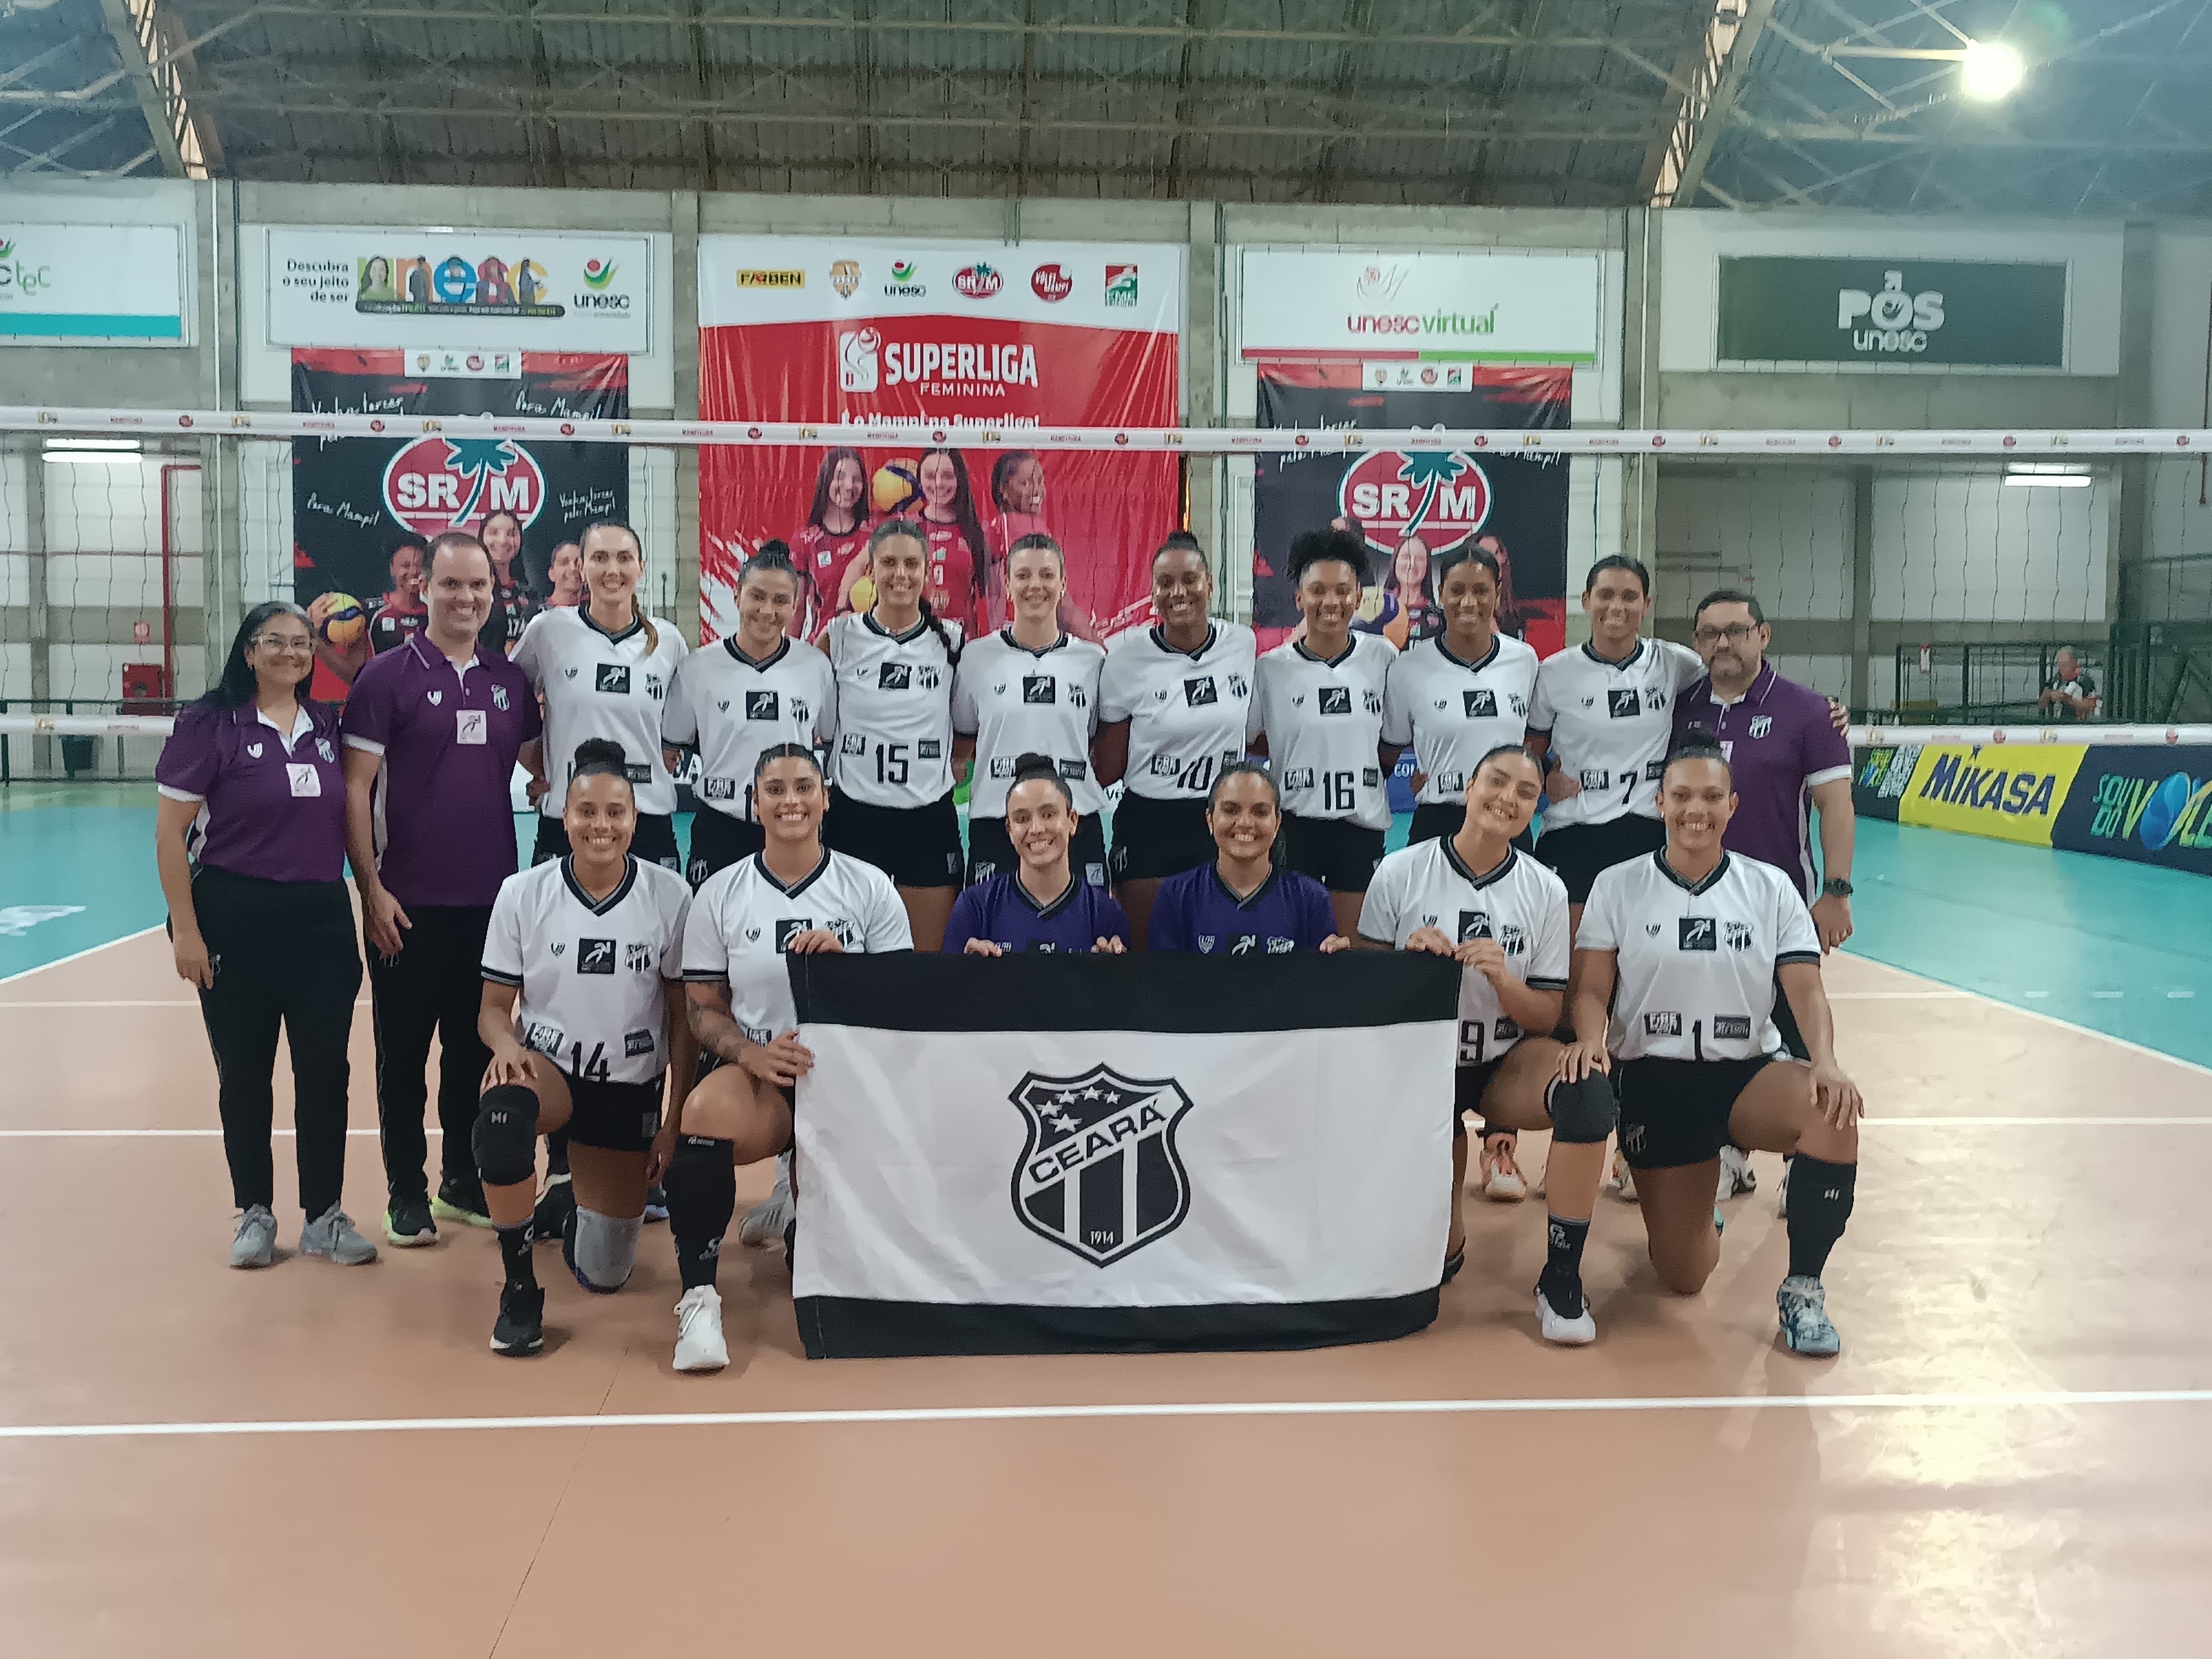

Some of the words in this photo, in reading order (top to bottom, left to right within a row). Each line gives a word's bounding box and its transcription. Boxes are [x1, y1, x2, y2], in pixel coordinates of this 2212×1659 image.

[287, 258, 349, 273] Descubra
[310, 290, 327, 302] de
[573, 293, 630, 309] unesc
[1838, 270, 1945, 331] PÓS
[1853, 330, 1928, 353] unesc
[885, 342, 1039, 388] SUPERLIGA
[920, 382, 1005, 397] FEMININA
[397, 472, 529, 511] SRM
[1352, 483, 1477, 520] SRM
[875, 743, 909, 785] 15
[1177, 755, 1214, 792] 10
[1324, 770, 1354, 811] 16
[1620, 770, 1638, 805] 7
[1918, 752, 2056, 816] MIKASA
[1460, 1020, 1484, 1062] 9
[1692, 1019, 1703, 1060] 1
[572, 1040, 611, 1082] 14
[1028, 1098, 1167, 1184] CEARÁ
[1090, 1230, 1114, 1245] 1914
